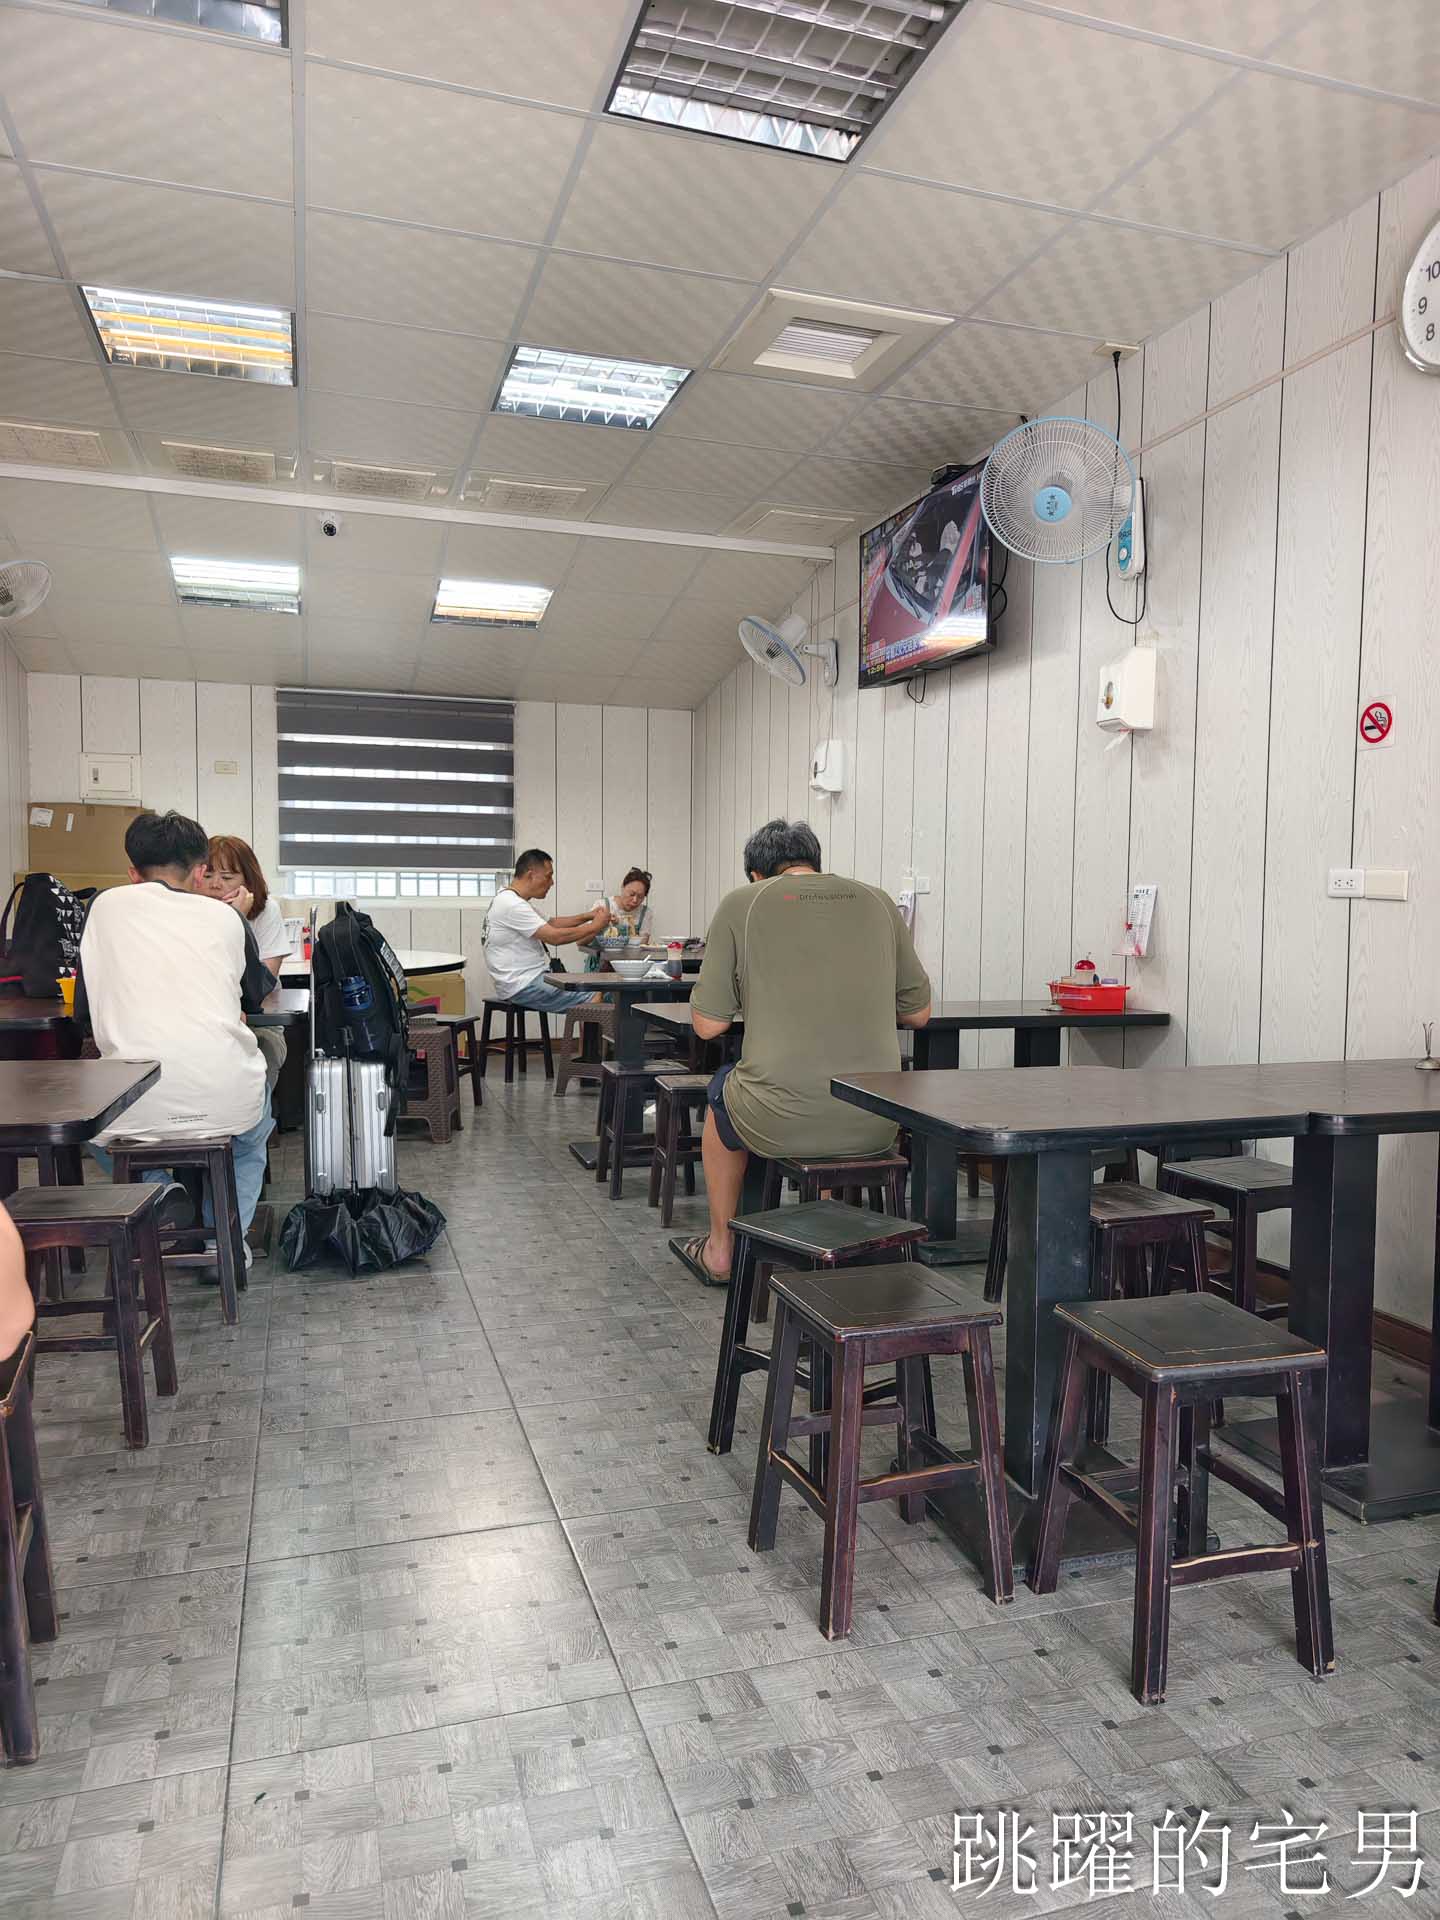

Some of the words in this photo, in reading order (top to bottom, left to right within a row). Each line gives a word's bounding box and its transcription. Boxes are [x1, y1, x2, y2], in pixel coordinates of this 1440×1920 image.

[1425, 261, 1440, 281] 10
[1418, 297, 1427, 315] 9
[1426, 323, 1435, 341] 8
